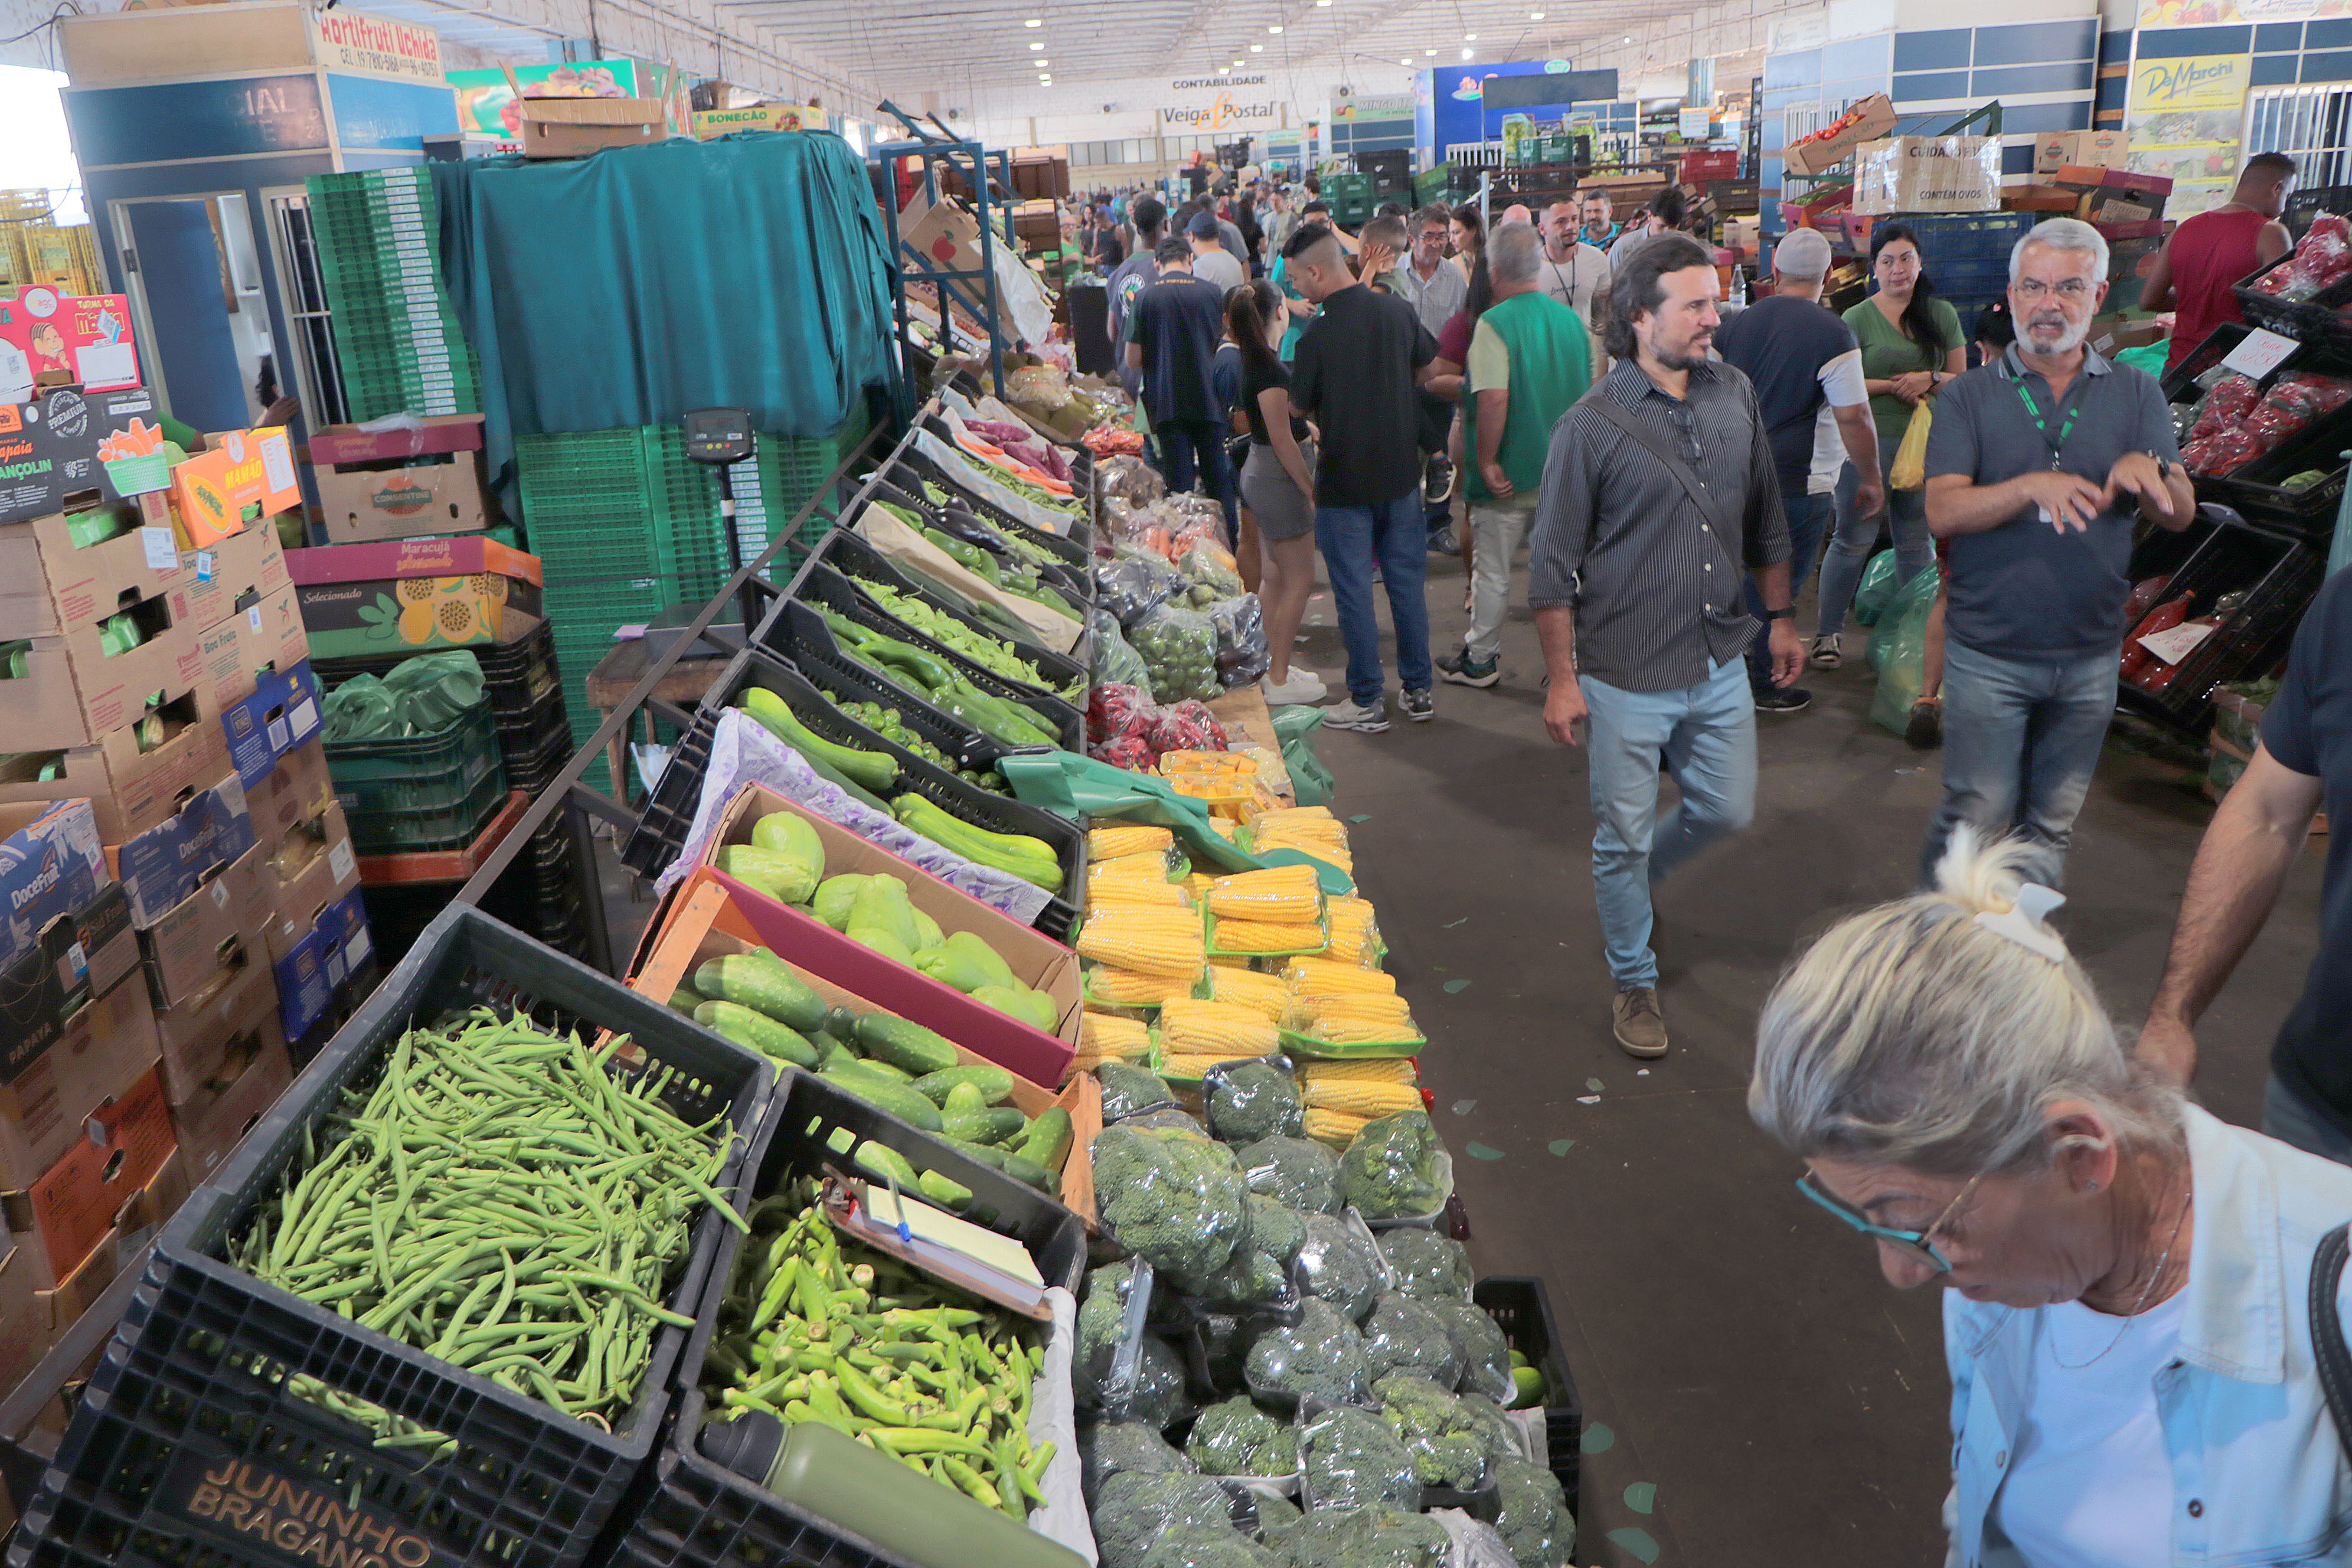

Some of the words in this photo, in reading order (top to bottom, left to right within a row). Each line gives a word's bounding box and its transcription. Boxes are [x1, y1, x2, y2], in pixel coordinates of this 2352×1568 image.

[321, 14, 395, 54] Hortifruti
[396, 24, 437, 61] Uchida
[1173, 76, 1267, 89] CONTABILIDADE
[708, 110, 768, 123] BONECÃO
[1164, 107, 1210, 126] Veiga
[1223, 102, 1274, 119] Postal
[1910, 146, 1961, 158] CUIDA
[1920, 188, 1956, 200] CONTÉM
[1958, 189, 1982, 199] OVOS
[76, 299, 103, 309] TURMA
[104, 299, 116, 308] DA
[47, 401, 87, 430] PREMIUM
[224, 458, 262, 491] MAMÃO
[401, 541, 450, 555] Maracujá
[303, 589, 362, 605] Selecionado
[206, 1459, 432, 1568] JUNINHO
